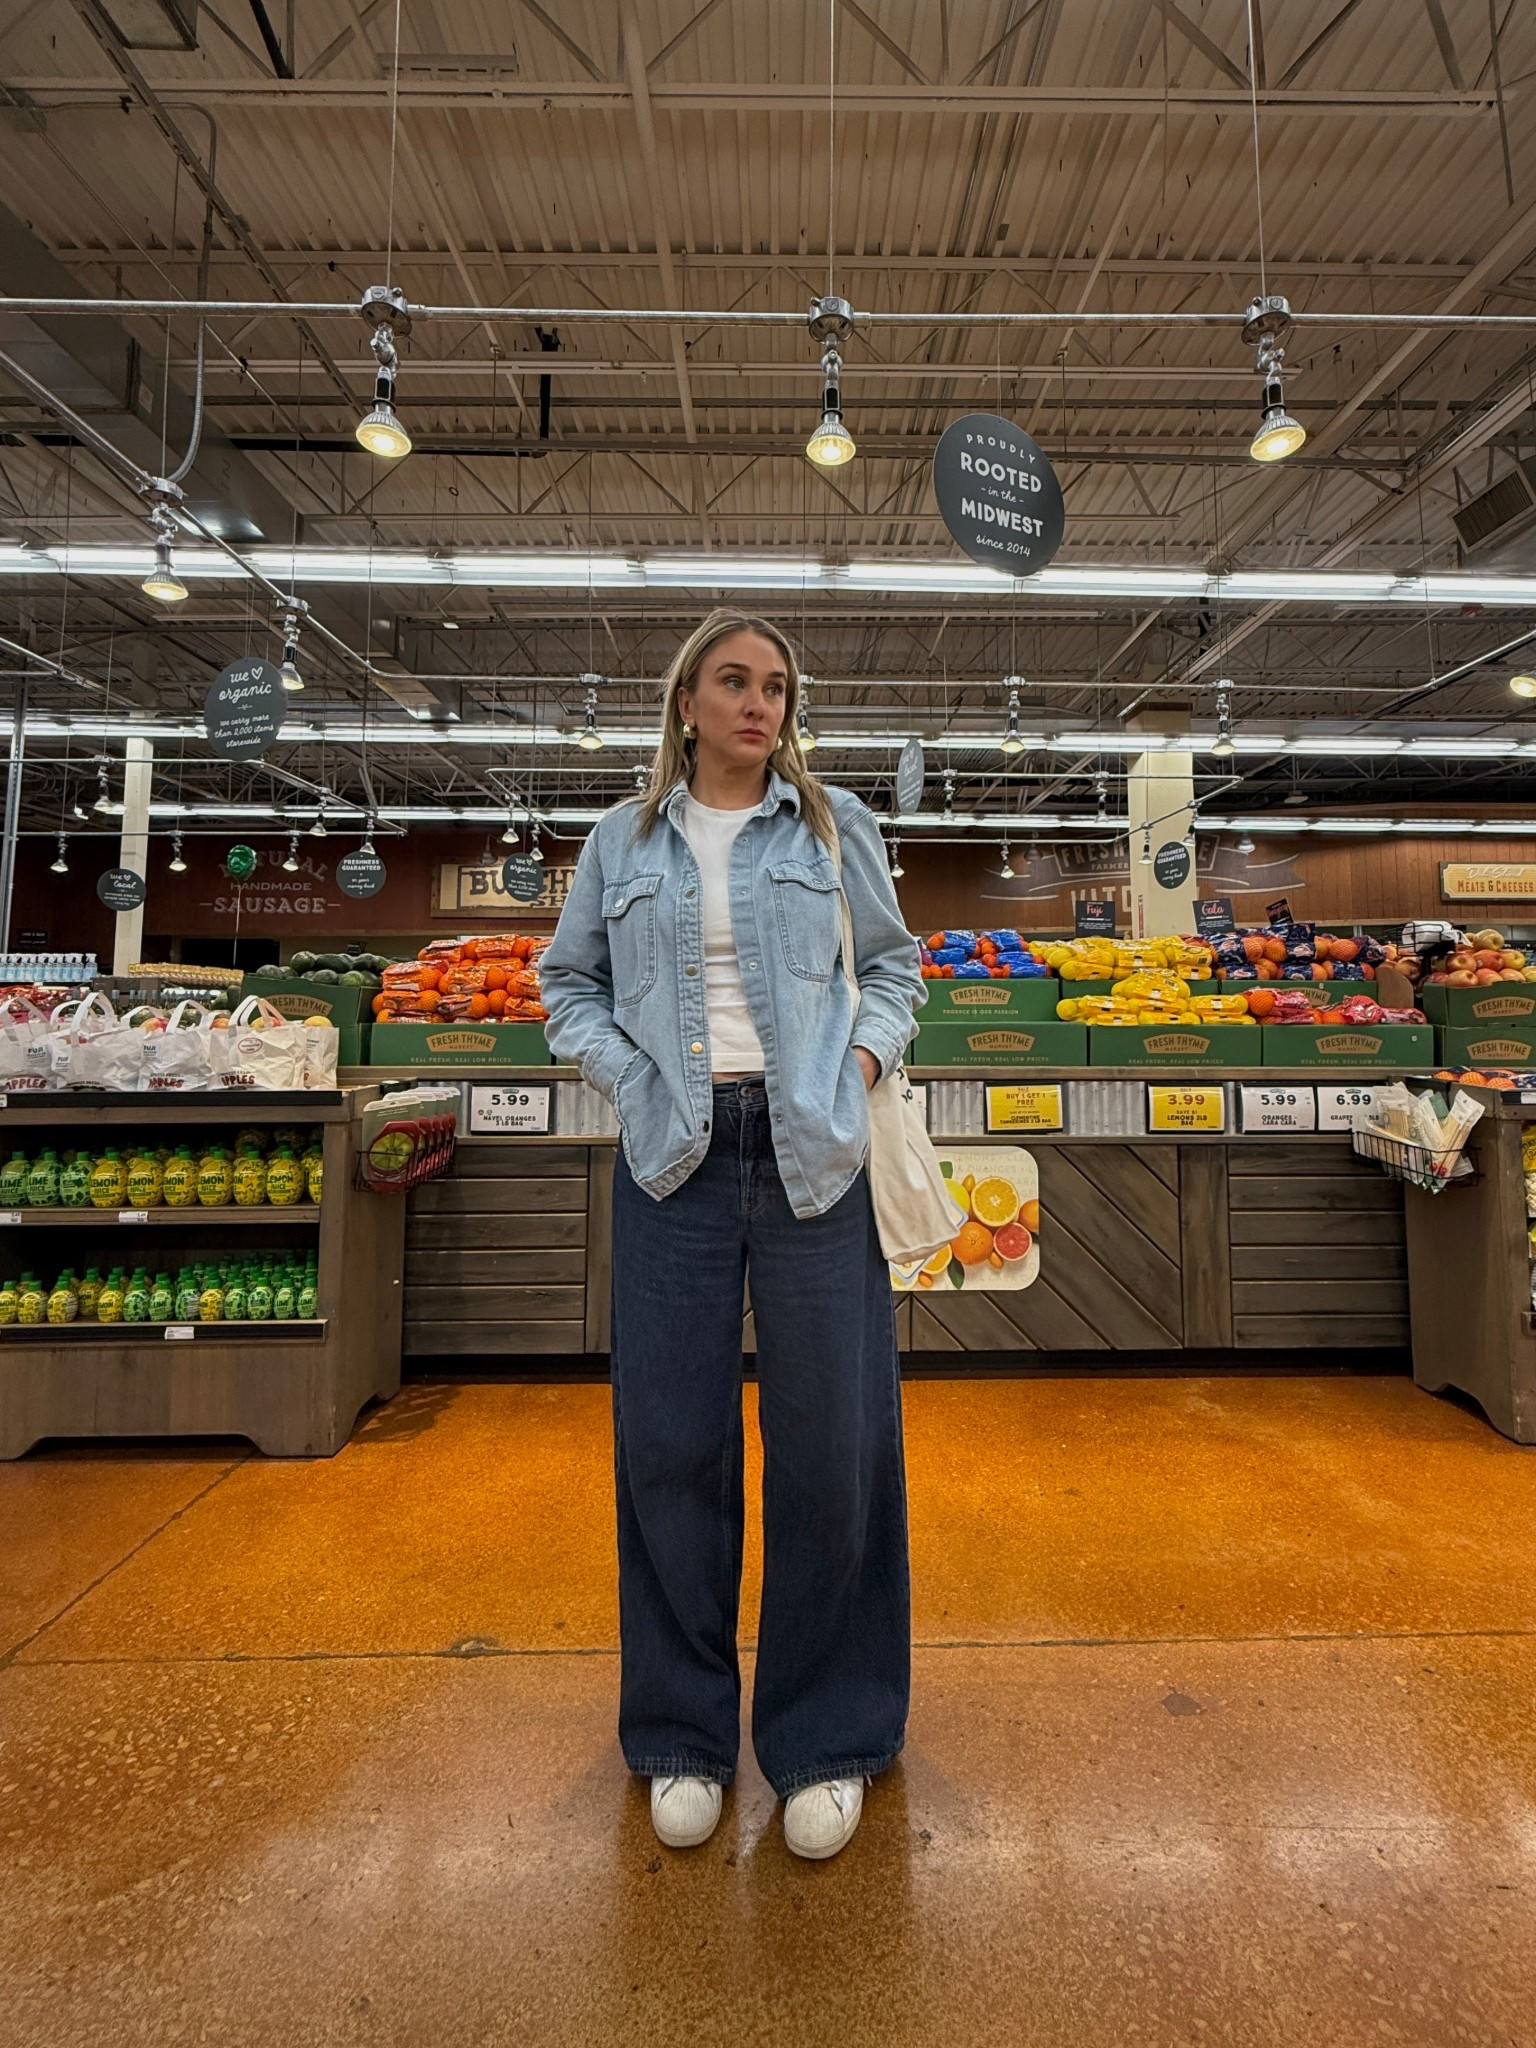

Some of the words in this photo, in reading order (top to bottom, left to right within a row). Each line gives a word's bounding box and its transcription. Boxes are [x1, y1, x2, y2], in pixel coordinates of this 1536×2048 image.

[966, 434, 1036, 464] PROUDLY
[960, 451, 1042, 493] ROOTED
[988, 486, 999, 497] in
[1001, 488, 1017, 504] the
[961, 497, 1044, 538] MIDWEST
[976, 533, 1004, 550] since
[1006, 541, 1031, 558] 2014
[230, 672, 250, 683] we
[219, 681, 272, 704] organic
[231, 717, 250, 726] carry
[252, 714, 270, 722] more
[214, 728, 233, 739] than
[234, 725, 253, 737] 2,000
[254, 723, 275, 733] items
[226, 735, 262, 748] storewide
[1061, 840, 1126, 868] FRESH
[1157, 847, 1185, 859] FRESHNESS
[1157, 853, 1187, 865] GUARANTEED
[510, 865, 537, 875] organic
[231, 882, 312, 891] HANDMADE
[1458, 880, 1485, 892] MEATS
[1488, 880, 1494, 892] &
[1496, 880, 1534, 892] CHEESES
[213, 897, 327, 914] SAUSAGE
[1202, 903, 1224, 916] Gala
[954, 989, 979, 1001] FRESH
[981, 988, 1008, 1001] THYME
[297, 997, 328, 1014] THYME
[1477, 1000, 1503, 1014] FRESH
[1505, 999, 1533, 1011] THYME
[431, 1034, 459, 1048] FRESH
[462, 1034, 492, 1048] THYME
[971, 1034, 999, 1048] FRESH
[1001, 1034, 1031, 1047] THYME
[1148, 1037, 1175, 1050] FRESH
[1177, 1036, 1206, 1050] THYME
[1320, 1037, 1348, 1050] FRESH
[1350, 1037, 1378, 1050] THYME
[1471, 1043, 1497, 1056] FRESH
[1499, 1043, 1528, 1056] THYME
[491, 1094, 530, 1106] 5.99
[1167, 1094, 1205, 1105] 3.99
[1261, 1094, 1297, 1106] 5.99
[1336, 1094, 1372, 1106] 6.99
[163, 1176, 185, 1186] EMON
[94, 1187, 110, 1195] JUICE
